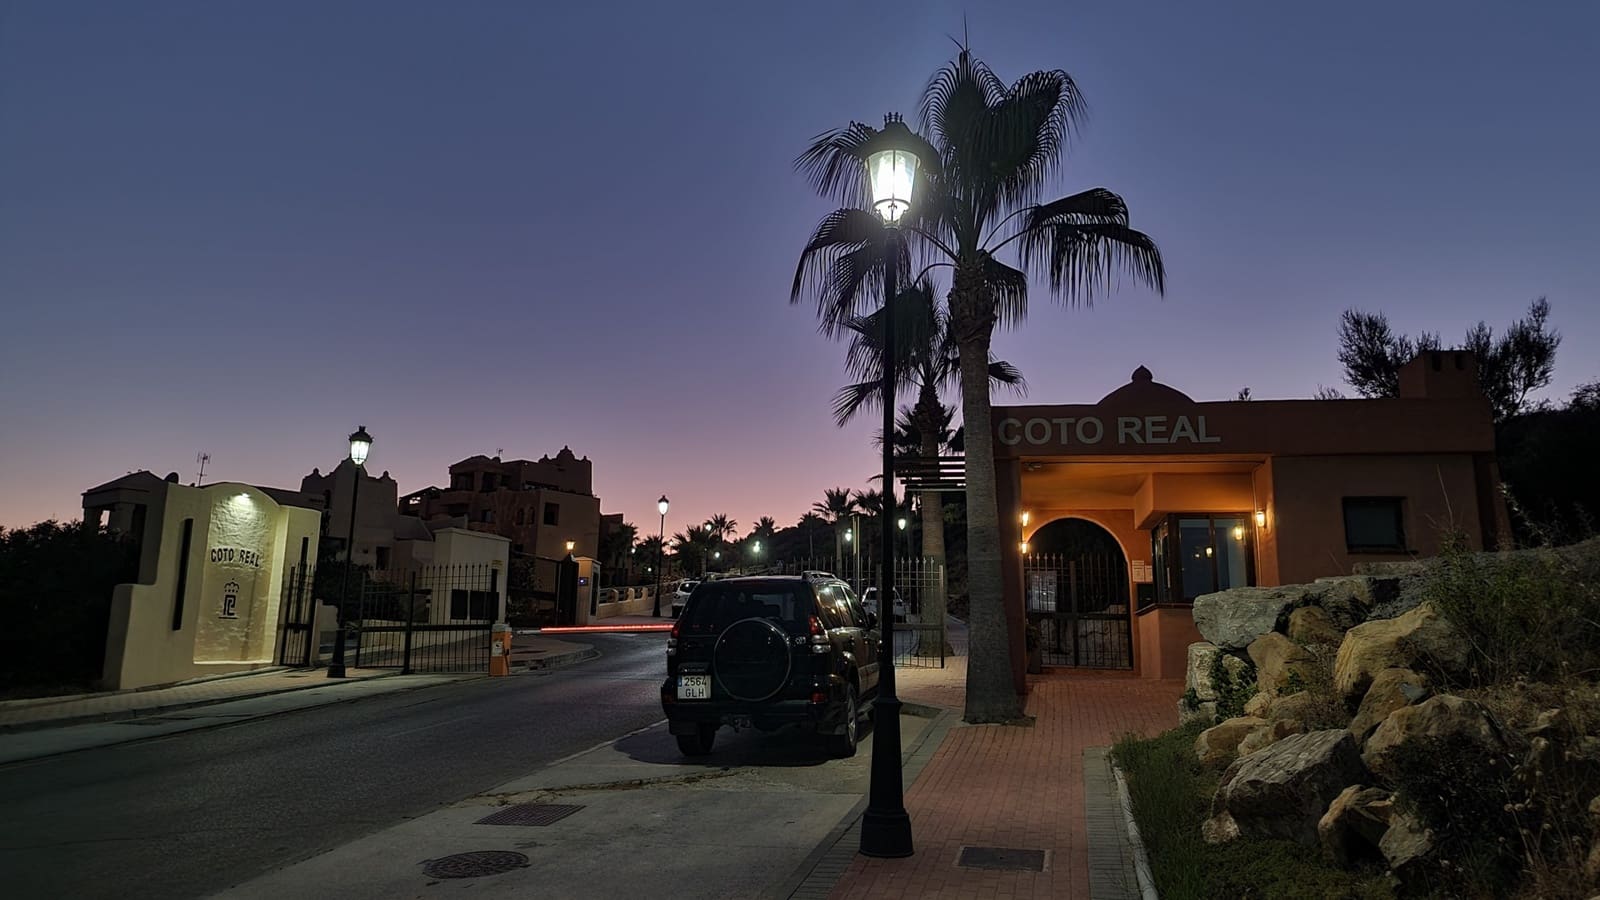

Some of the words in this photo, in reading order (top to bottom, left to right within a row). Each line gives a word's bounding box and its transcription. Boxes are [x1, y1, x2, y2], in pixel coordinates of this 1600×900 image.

[998, 417, 1104, 445] COTO
[1117, 415, 1221, 444] REAL
[210, 548, 234, 562] COTO
[239, 549, 260, 567] REAL
[684, 676, 706, 687] 2564
[685, 688, 704, 698] GLH
